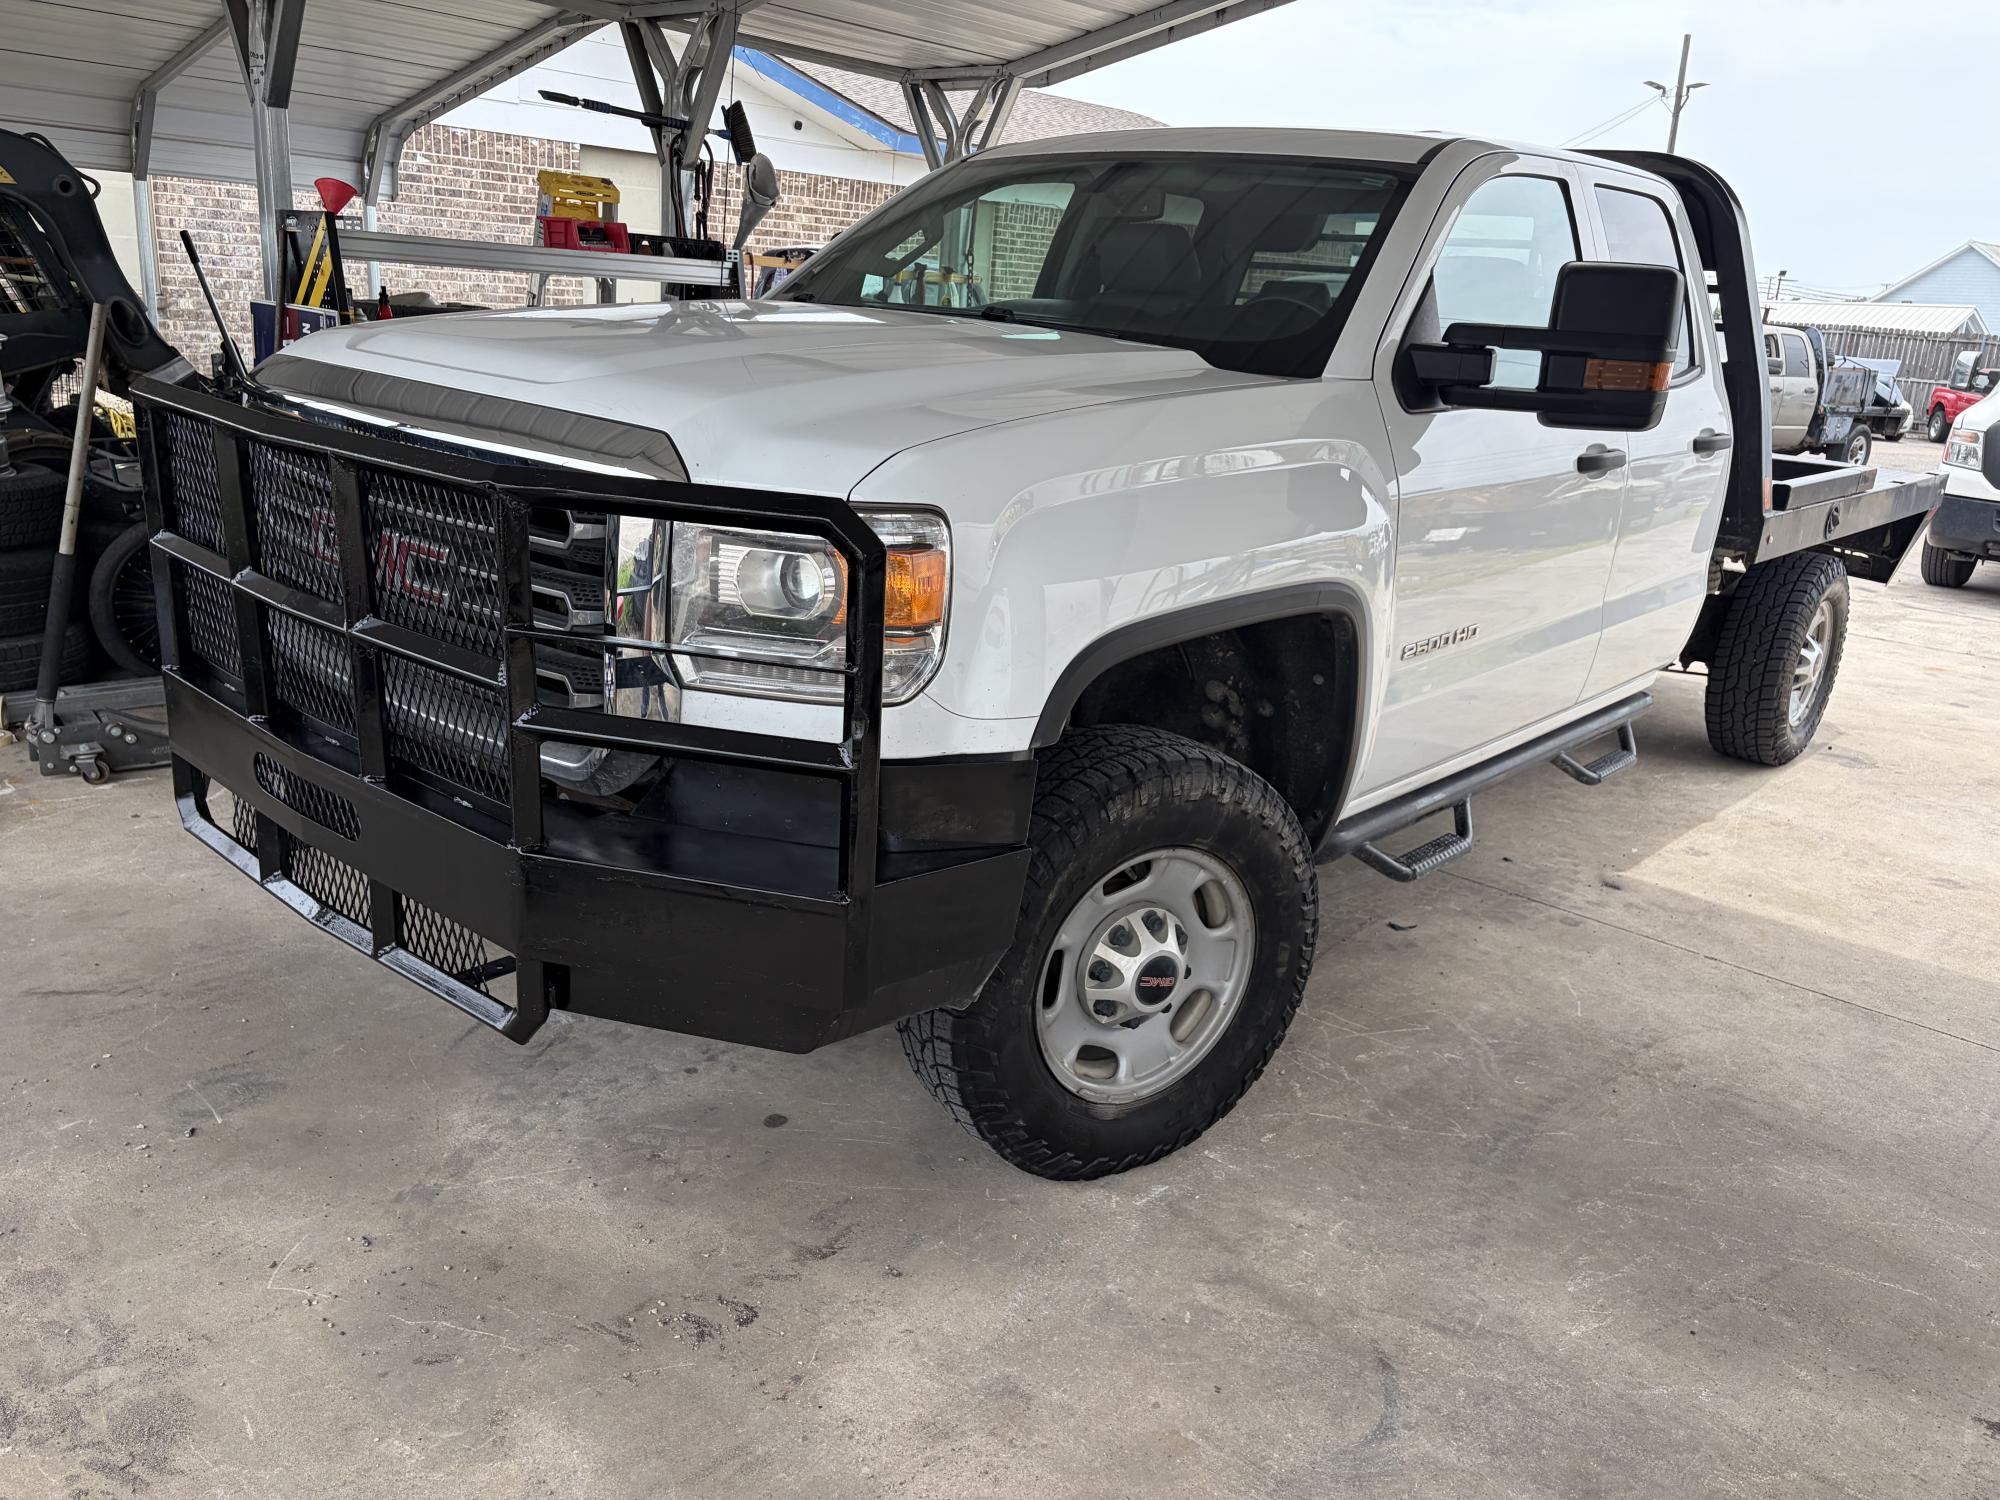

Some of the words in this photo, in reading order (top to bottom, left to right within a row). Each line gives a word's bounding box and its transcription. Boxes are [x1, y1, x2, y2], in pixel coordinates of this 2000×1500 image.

[1400, 631, 1451, 661] 2500
[1452, 623, 1480, 645] HD
[1140, 976, 1175, 987] GMC
